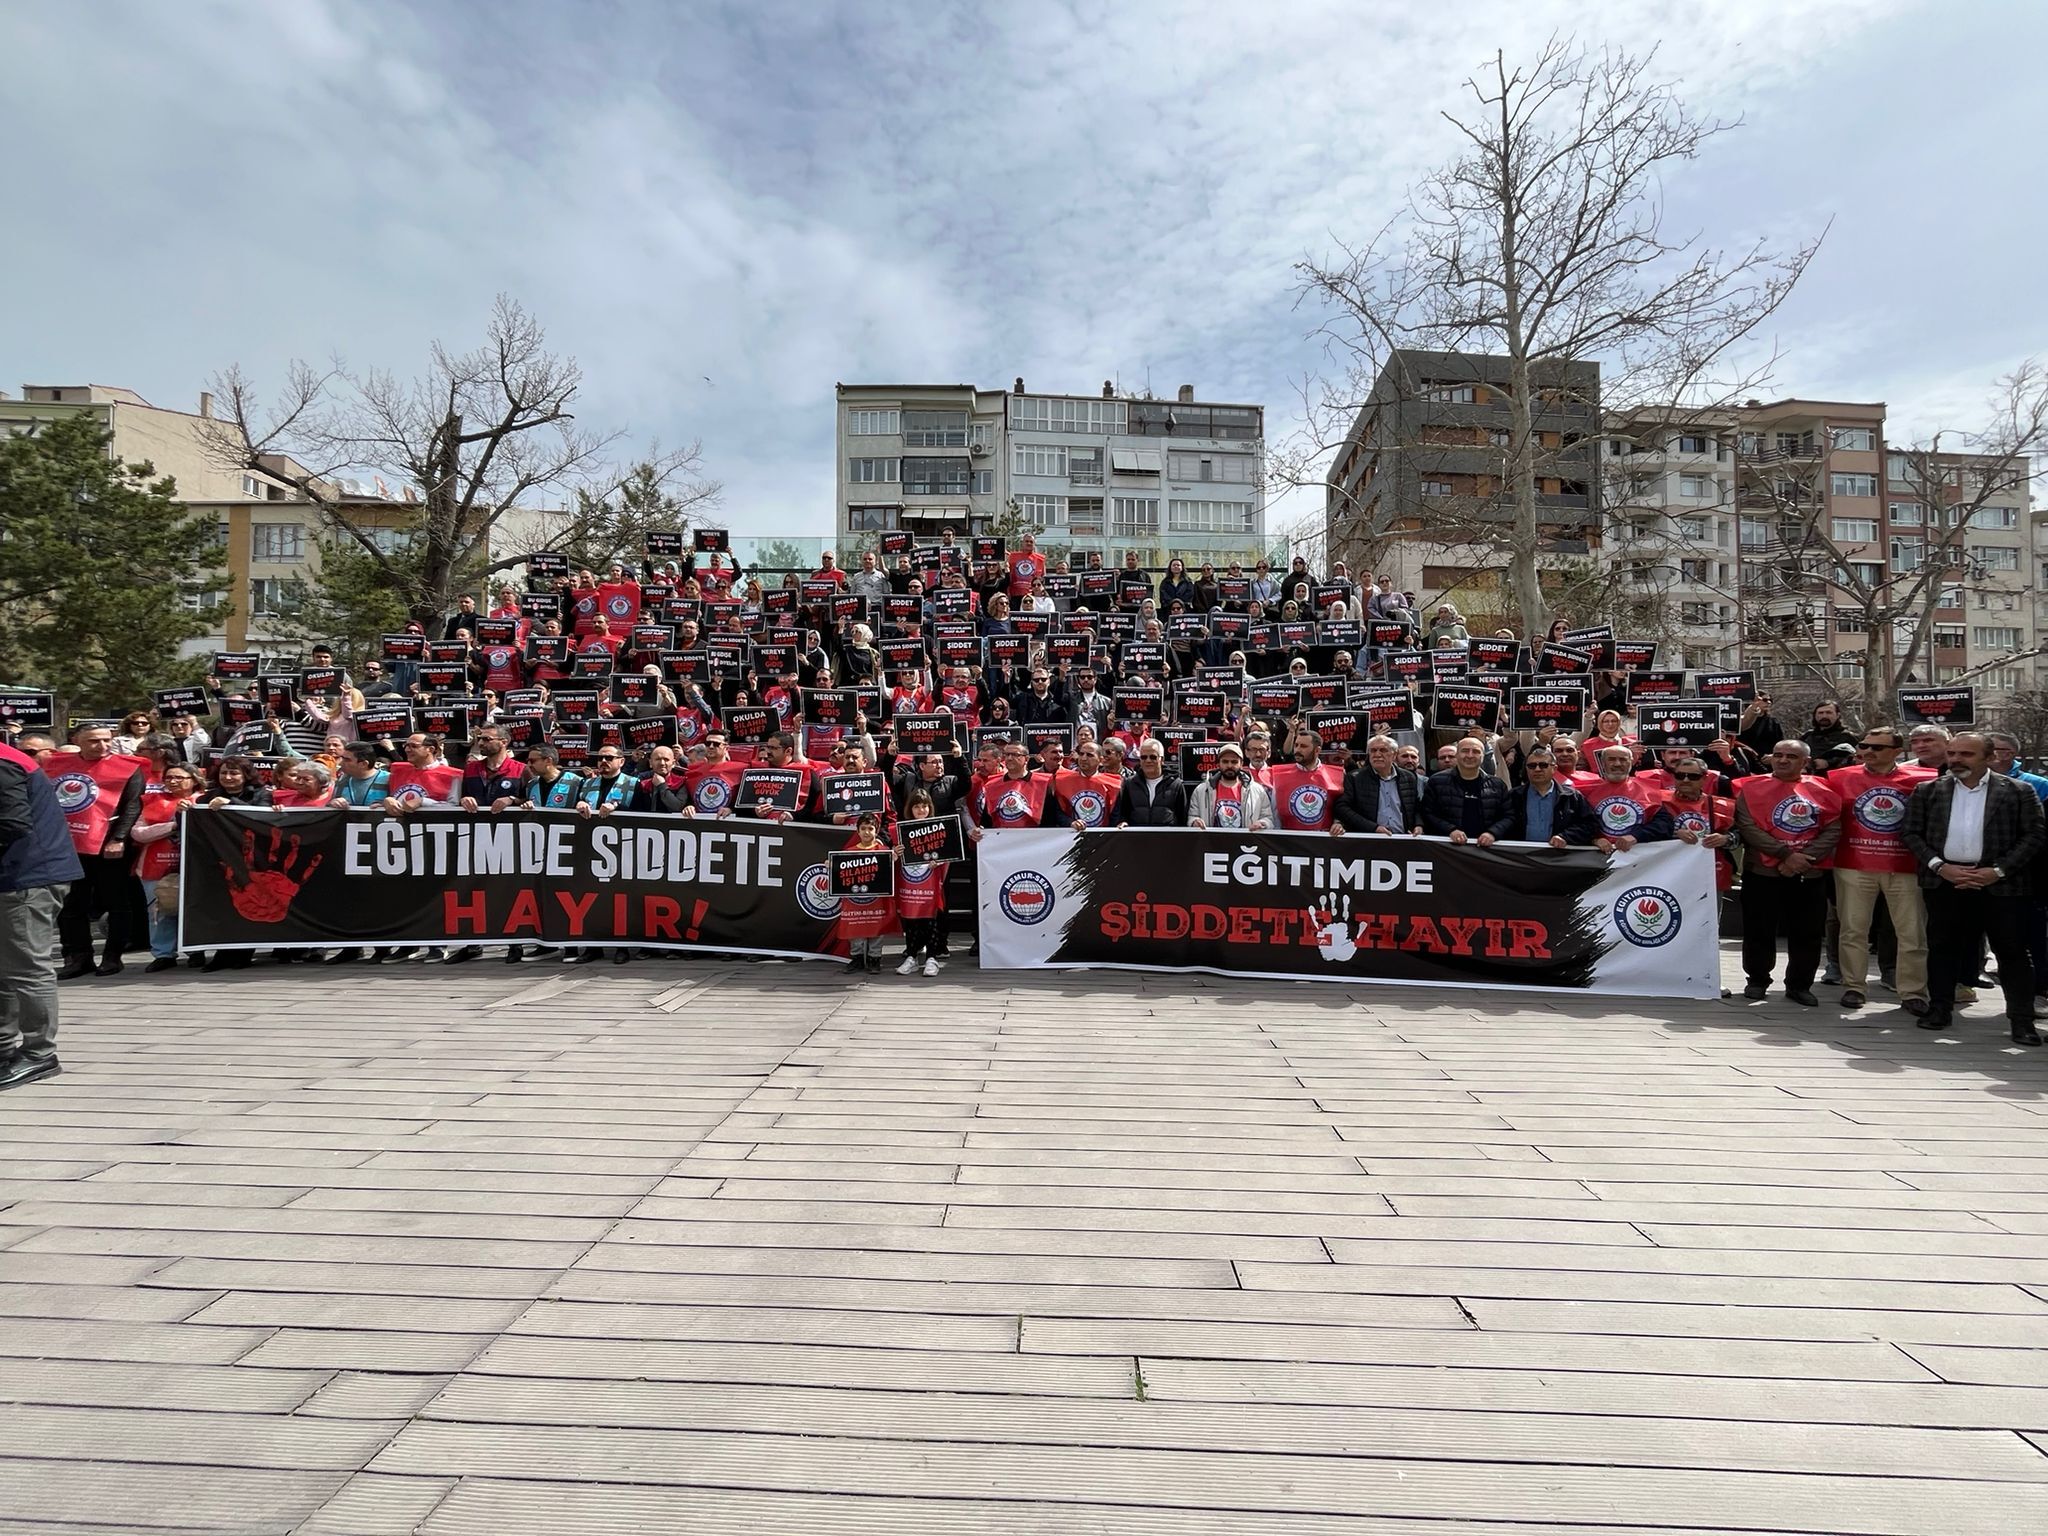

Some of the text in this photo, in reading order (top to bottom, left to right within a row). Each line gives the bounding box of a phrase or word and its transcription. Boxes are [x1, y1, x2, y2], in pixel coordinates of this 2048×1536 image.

[995, 640, 1019, 648] ŞİDDET
[1479, 644, 1508, 652] ŞİDDET
[1545, 649, 1568, 659] OKULDA
[1394, 656, 1422, 665] ŞİDDET
[307, 671, 334, 679] OKULDA
[1707, 677, 1741, 686] ŞİDDET
[814, 693, 844, 701] NEREYE
[1439, 692, 1497, 703] OKULDA ŞİDDETE
[1527, 695, 1568, 704] ŞİDDET
[1186, 698, 1214, 706] ŞİDDET
[733, 711, 766, 723] OKULDA
[1669, 710, 1703, 719] GİDİŞE
[630, 720, 663, 732] OKULDA
[906, 721, 940, 730] ŞİDDET
[1318, 716, 1356, 728] OKULDA
[1680, 722, 1714, 730] DİYELİM
[1203, 755, 1215, 763] BU
[770, 776, 797, 784] ŞİDDETE
[834, 779, 872, 789] BU GİDİŞE
[909, 822, 945, 839] OKULDA
[927, 840, 945, 850] NE?
[345, 818, 784, 887] EĞİTİMDE ŞİDDETE
[840, 856, 878, 869] OKULDA
[1204, 845, 1434, 894] EĞİTİMDE
[857, 874, 875, 883] NE?
[1004, 872, 1050, 890] MEMUR-SEN
[444, 889, 709, 941] HAYIR!
[1355, 912, 1552, 960] HAYIR
